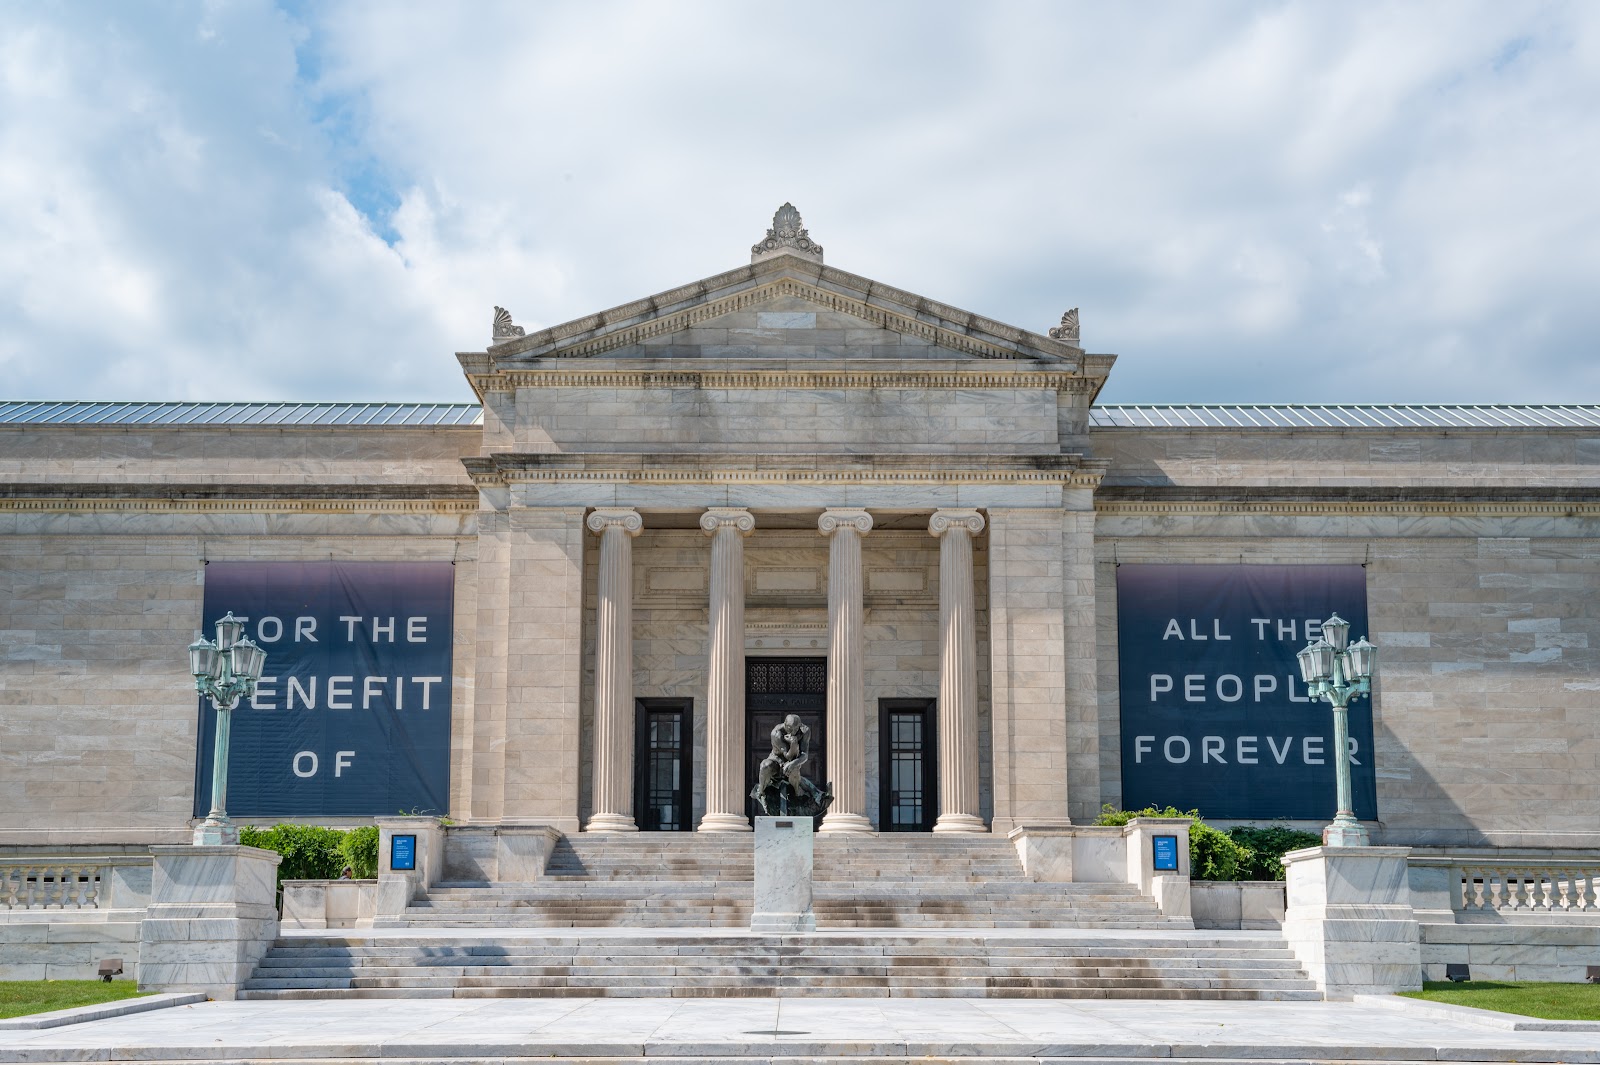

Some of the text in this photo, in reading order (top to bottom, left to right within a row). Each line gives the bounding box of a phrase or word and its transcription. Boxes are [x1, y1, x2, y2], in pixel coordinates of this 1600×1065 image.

[225, 616, 428, 643] OR THE
[1162, 618, 1323, 641] ALL THE
[1150, 674, 1341, 703] PEOPL
[292, 750, 356, 778] OF
